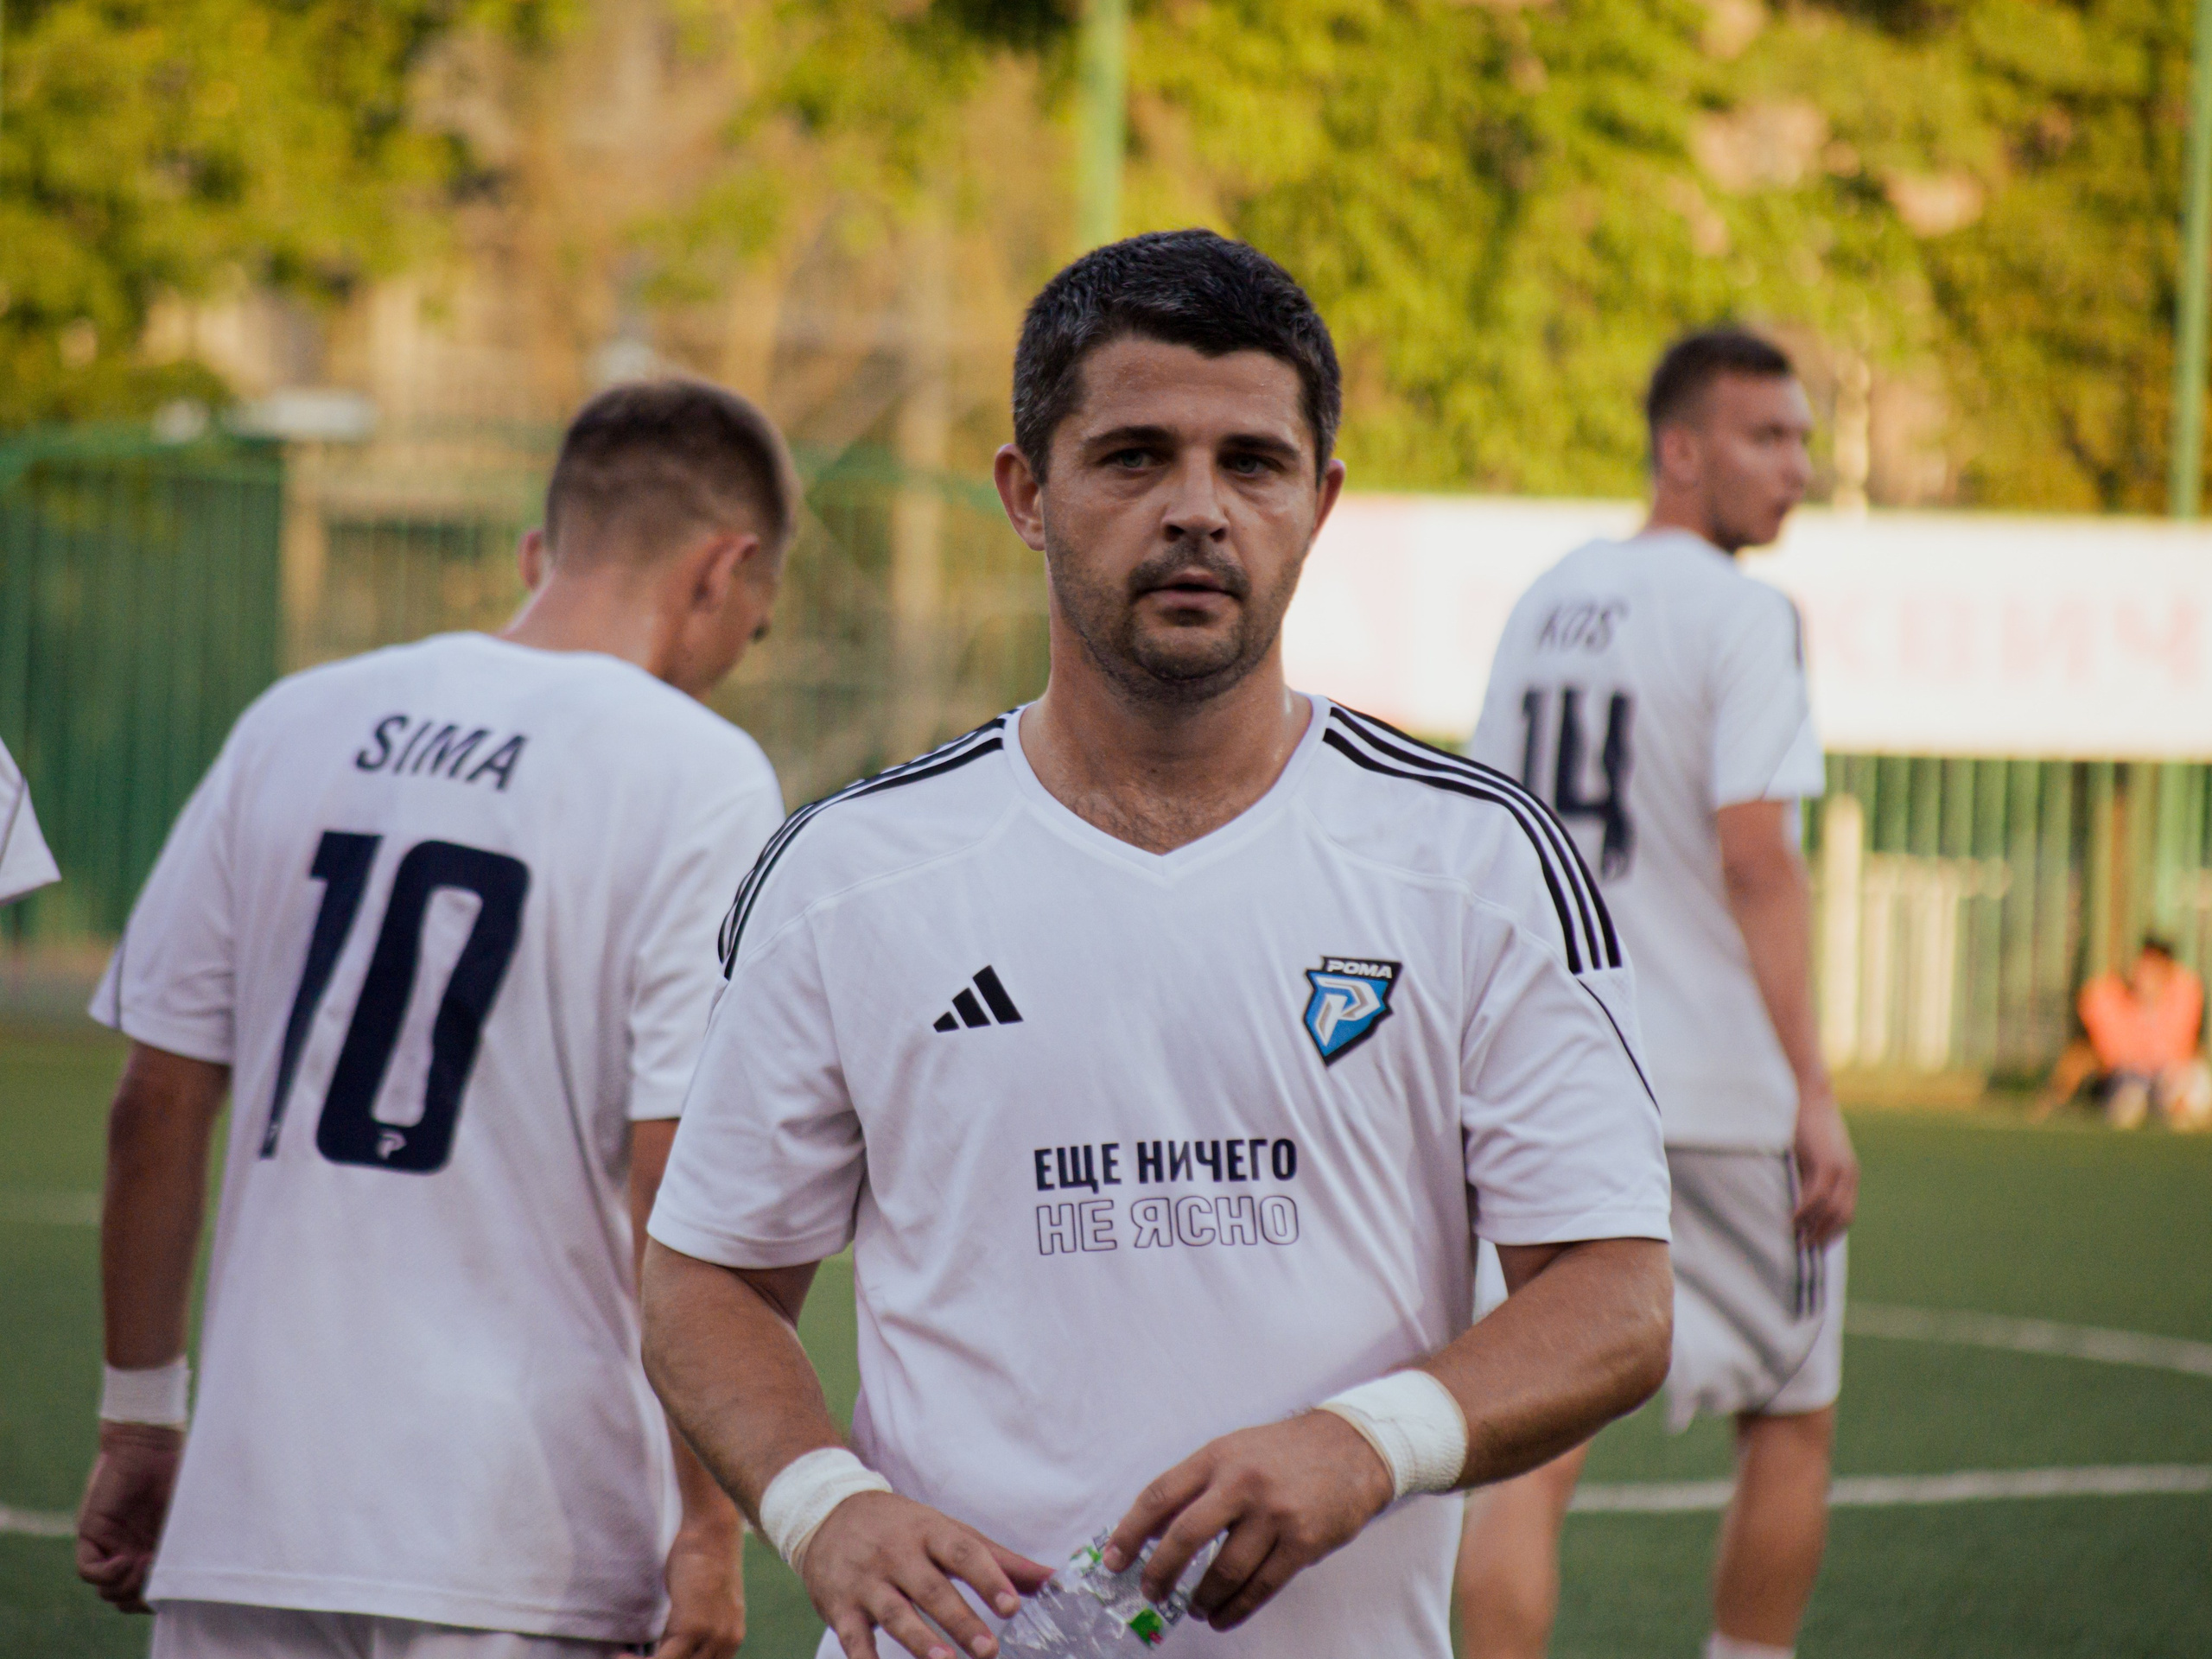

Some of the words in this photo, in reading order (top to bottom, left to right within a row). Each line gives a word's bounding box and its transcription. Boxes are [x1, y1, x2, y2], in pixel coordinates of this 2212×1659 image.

[354, 714, 530, 791] SIMA
[260, 830, 532, 1176] 10
[1034, 1142, 1122, 1193] ЕЩЕ
[1136, 1138, 1296, 1183] НИЧЕГО
[1036, 1198, 1117, 1255] НЕ
[1129, 1195, 1300, 1249] ЯСНО
